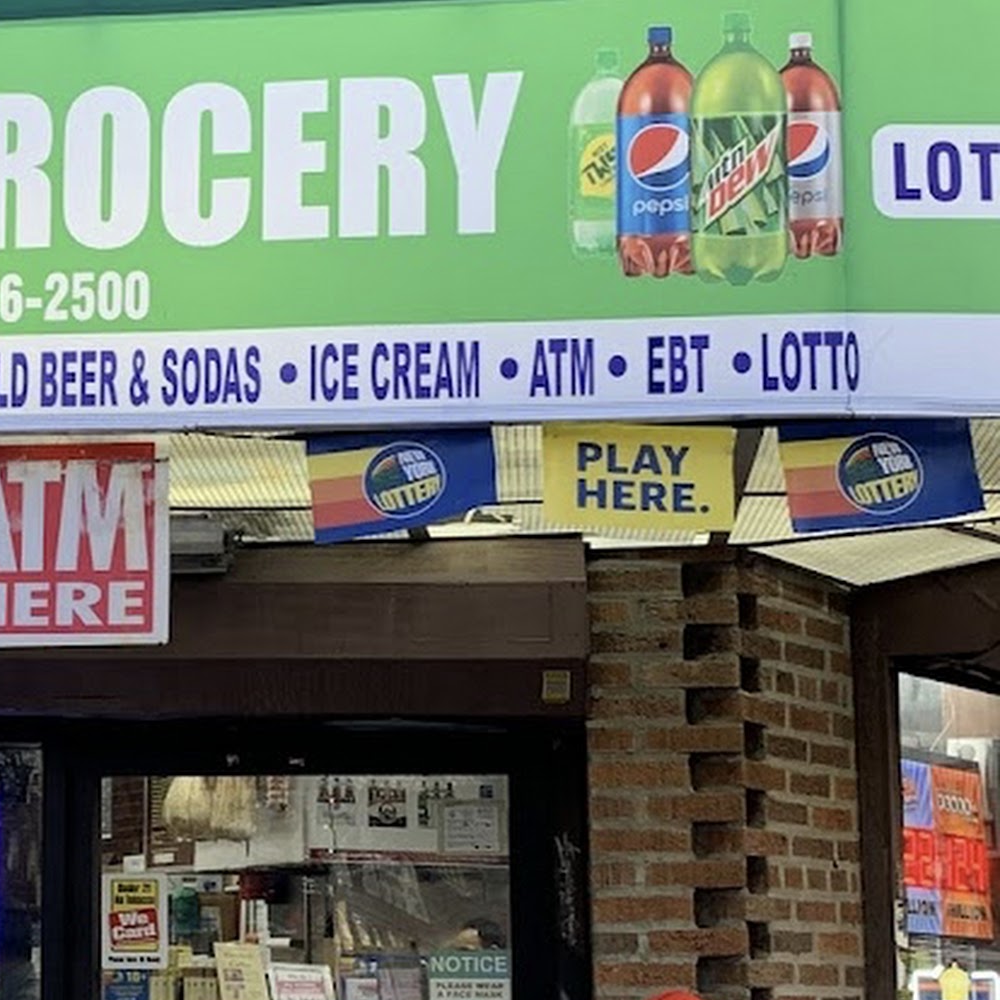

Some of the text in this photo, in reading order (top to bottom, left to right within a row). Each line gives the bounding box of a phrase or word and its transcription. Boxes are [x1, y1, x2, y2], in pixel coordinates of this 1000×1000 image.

[893, 141, 1000, 202] LOT
[40, 350, 116, 408] BEER
[129, 351, 150, 405] &
[161, 345, 261, 406] SODAS
[310, 340, 480, 402] ICE CREAM
[529, 337, 595, 398] ATM
[648, 335, 710, 395] EBT
[762, 330, 860, 392] LOTTO
[576, 442, 690, 476] PLAY
[576, 477, 710, 514] HERE.
[431, 955, 509, 974] NOTICE
